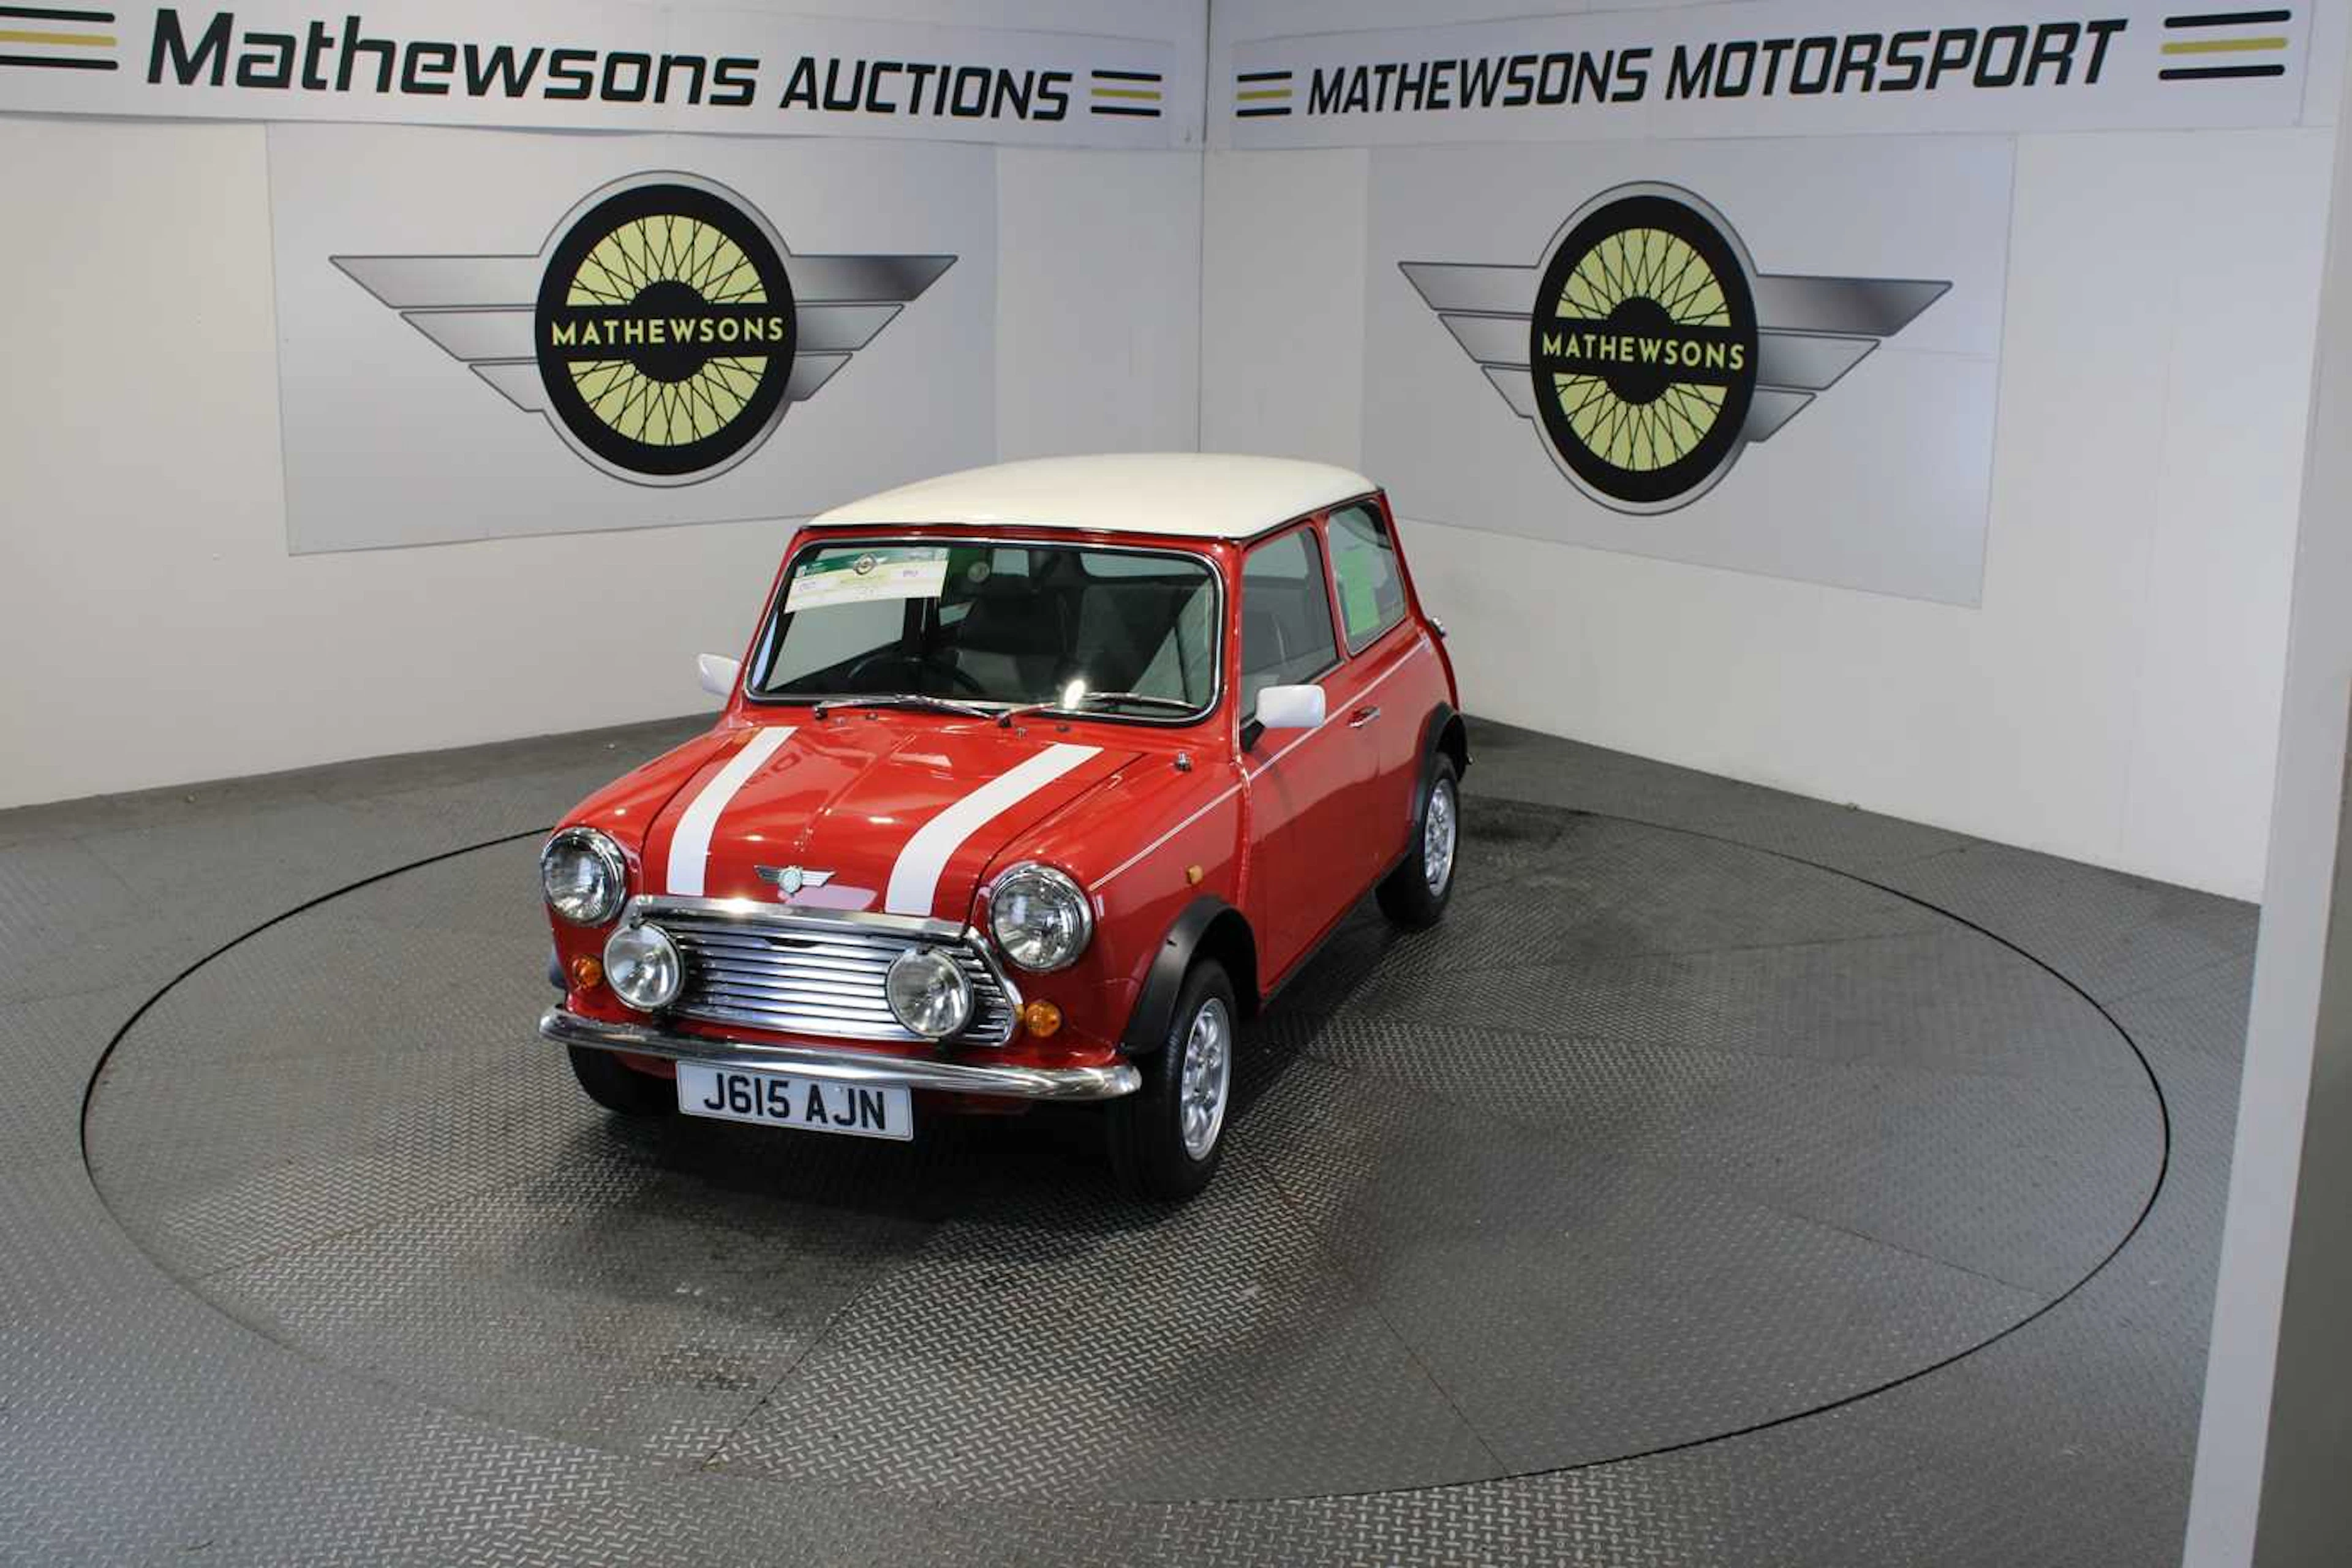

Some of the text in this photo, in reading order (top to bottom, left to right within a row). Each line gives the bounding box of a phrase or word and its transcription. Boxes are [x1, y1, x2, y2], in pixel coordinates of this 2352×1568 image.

[147, 9, 1072, 121] Mathewsons AUCTIONS
[1308, 19, 2128, 115] MATHEWSONS MOTORSPORT
[552, 317, 783, 345] MATHEWSONS
[1542, 333, 1744, 369] MATHEWSONS
[704, 1073, 885, 1129] J615 AJN
